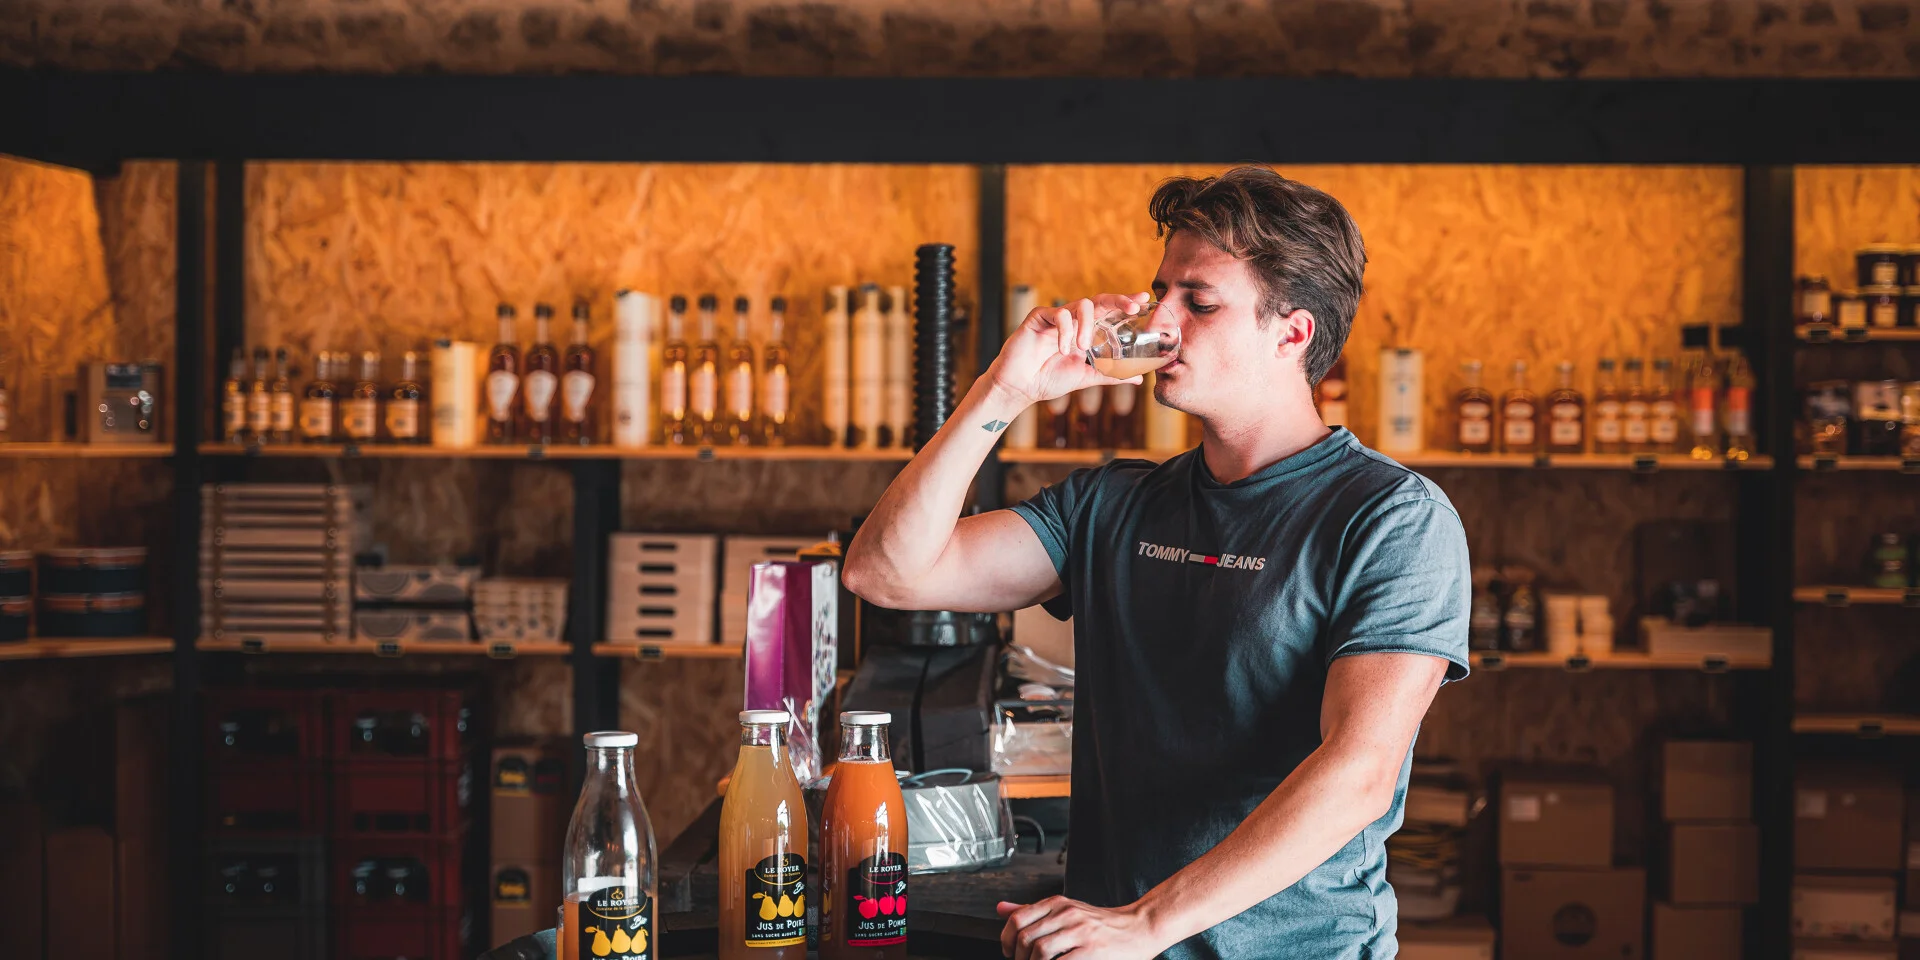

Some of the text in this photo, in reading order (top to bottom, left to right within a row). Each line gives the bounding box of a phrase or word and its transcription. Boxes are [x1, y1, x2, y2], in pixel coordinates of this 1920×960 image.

[1138, 541, 1266, 571] TOMMY JEANS
[880, 864, 902, 873] ROYER
[756, 921, 773, 930] JUS
